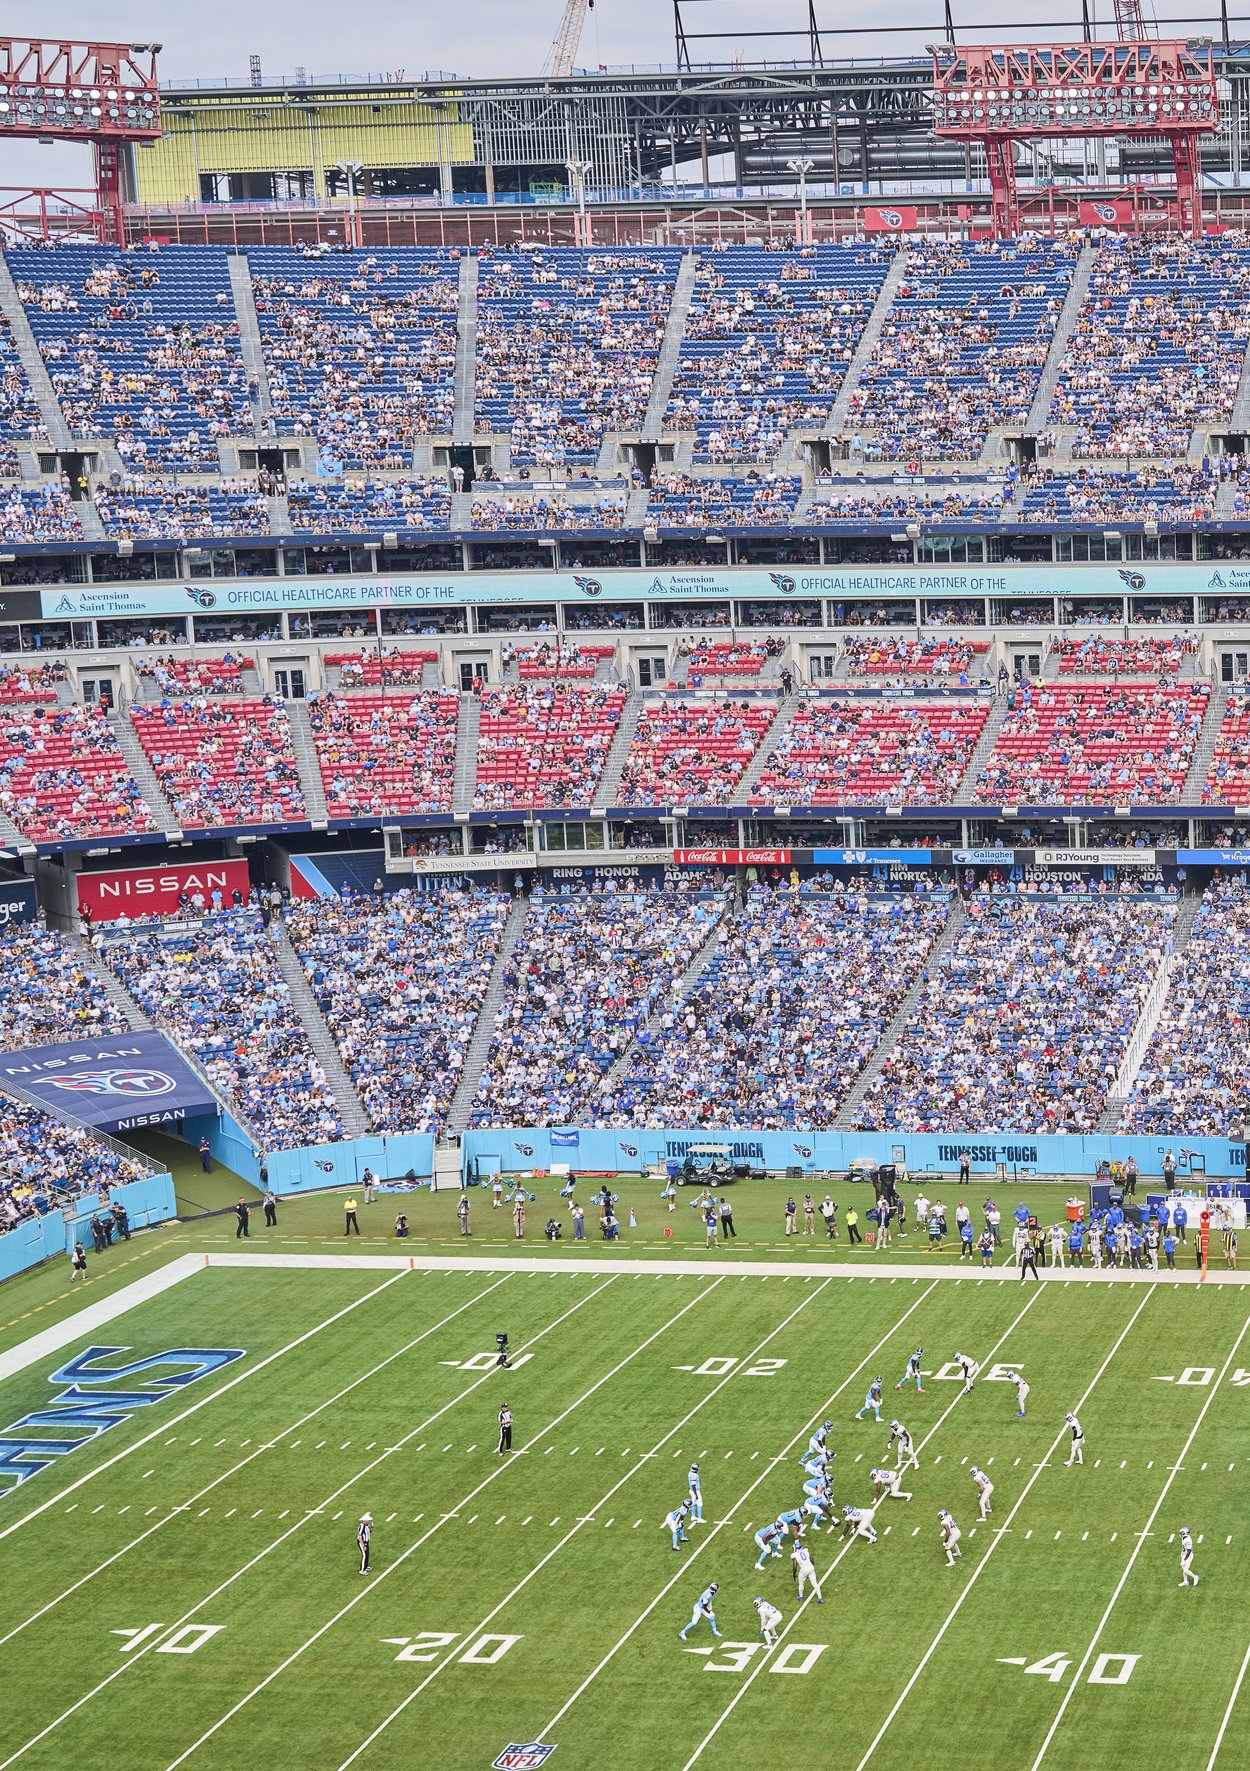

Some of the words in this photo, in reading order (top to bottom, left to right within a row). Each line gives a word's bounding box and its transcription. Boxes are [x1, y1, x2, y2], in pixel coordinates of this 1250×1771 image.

[670, 576, 714, 584] Ascension
[801, 578, 846, 590] OFFICIAL
[849, 577, 916, 590] HEALTHCARE
[920, 577, 967, 590] PARTNER
[970, 578, 986, 590] OF
[987, 578, 1006, 590] THE
[228, 590, 279, 604] OFFICIAL
[282, 588, 356, 602] HEALTHCARE
[361, 586, 412, 599] PARTNER
[416, 587, 432, 598] OF
[434, 586, 454, 598] THE
[670, 586, 692, 594] Saint
[694, 585, 729, 594] Thomas
[79, 592, 130, 601] Ascension
[80, 602, 106, 612] Saint
[108, 602, 146, 611] Thomas
[688, 850, 718, 862] Coca-Cola
[746, 850, 777, 862] Coca-Cola
[974, 851, 1013, 860] Gallagher
[1056, 854, 1100, 863] RJYoung
[430, 862, 471, 870] TENNESSEE
[493, 858, 534, 866] UNIVERSITY
[552, 868, 582, 878] RING
[594, 867, 640, 877] HONOR
[1025, 872, 1081, 882] HOUSTON
[100, 872, 227, 898] NISSAN
[6, 1047, 142, 1075] NISSAN
[118, 1109, 186, 1130] NISSAN
[729, 1142, 764, 1158] TOUGH
[938, 1145, 997, 1162] TENNESSEE
[1000, 1146, 1038, 1162] TOUGH
[1078, 1207, 1084, 1216] G
[1030, 1217, 1036, 1225] 2
[690, 1358, 788, 1376] 20
[119, 1624, 228, 1654] 10
[394, 1632, 525, 1664] 20
[703, 1642, 830, 1674] 30
[1024, 1652, 1142, 1684] 40
[499, 1754, 540, 1768] NFL
